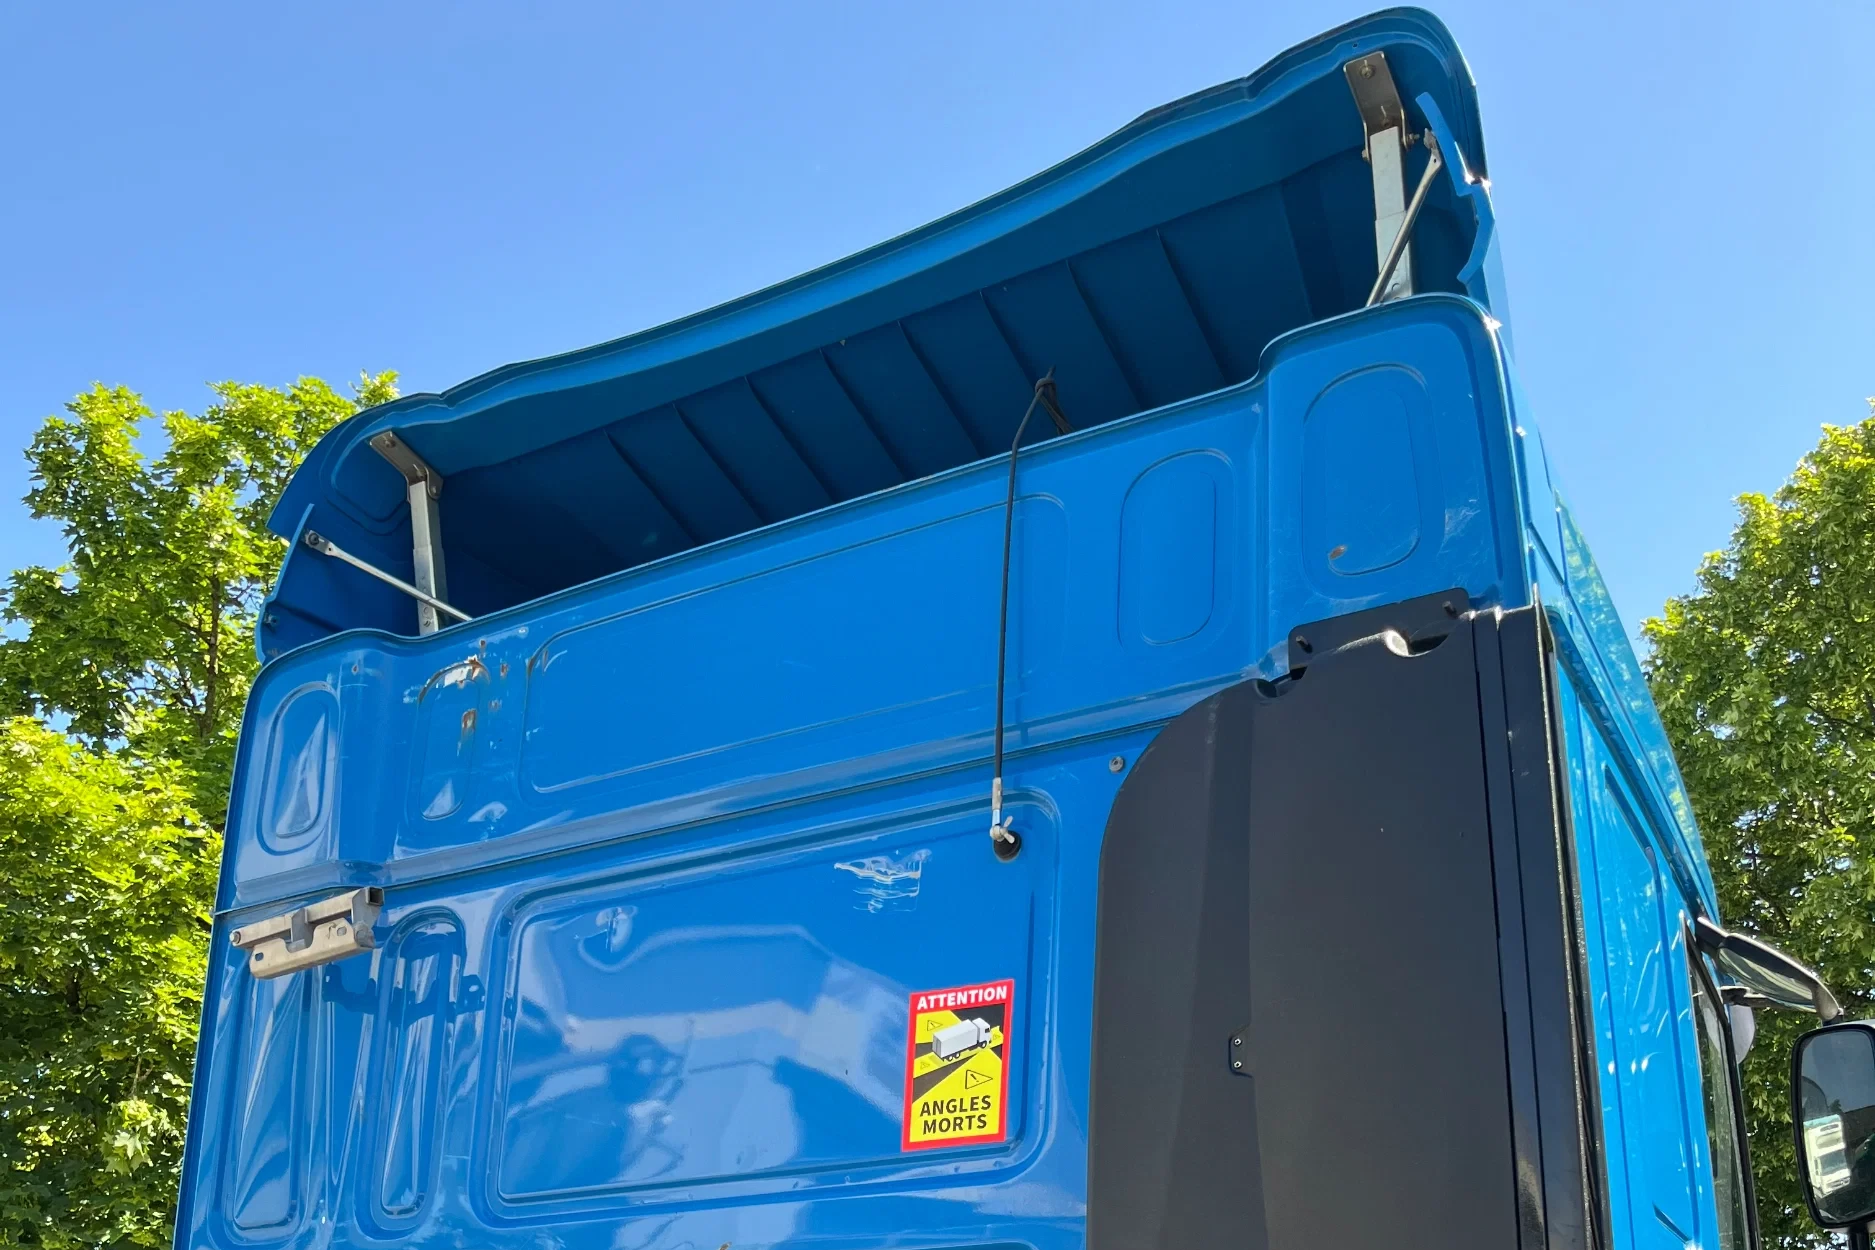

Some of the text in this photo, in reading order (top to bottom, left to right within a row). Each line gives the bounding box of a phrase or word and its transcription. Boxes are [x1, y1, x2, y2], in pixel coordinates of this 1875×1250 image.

[917, 986, 1007, 1010] ATTENTION
[920, 1095, 991, 1116] ANGLES
[922, 1114, 987, 1134] MORTS
